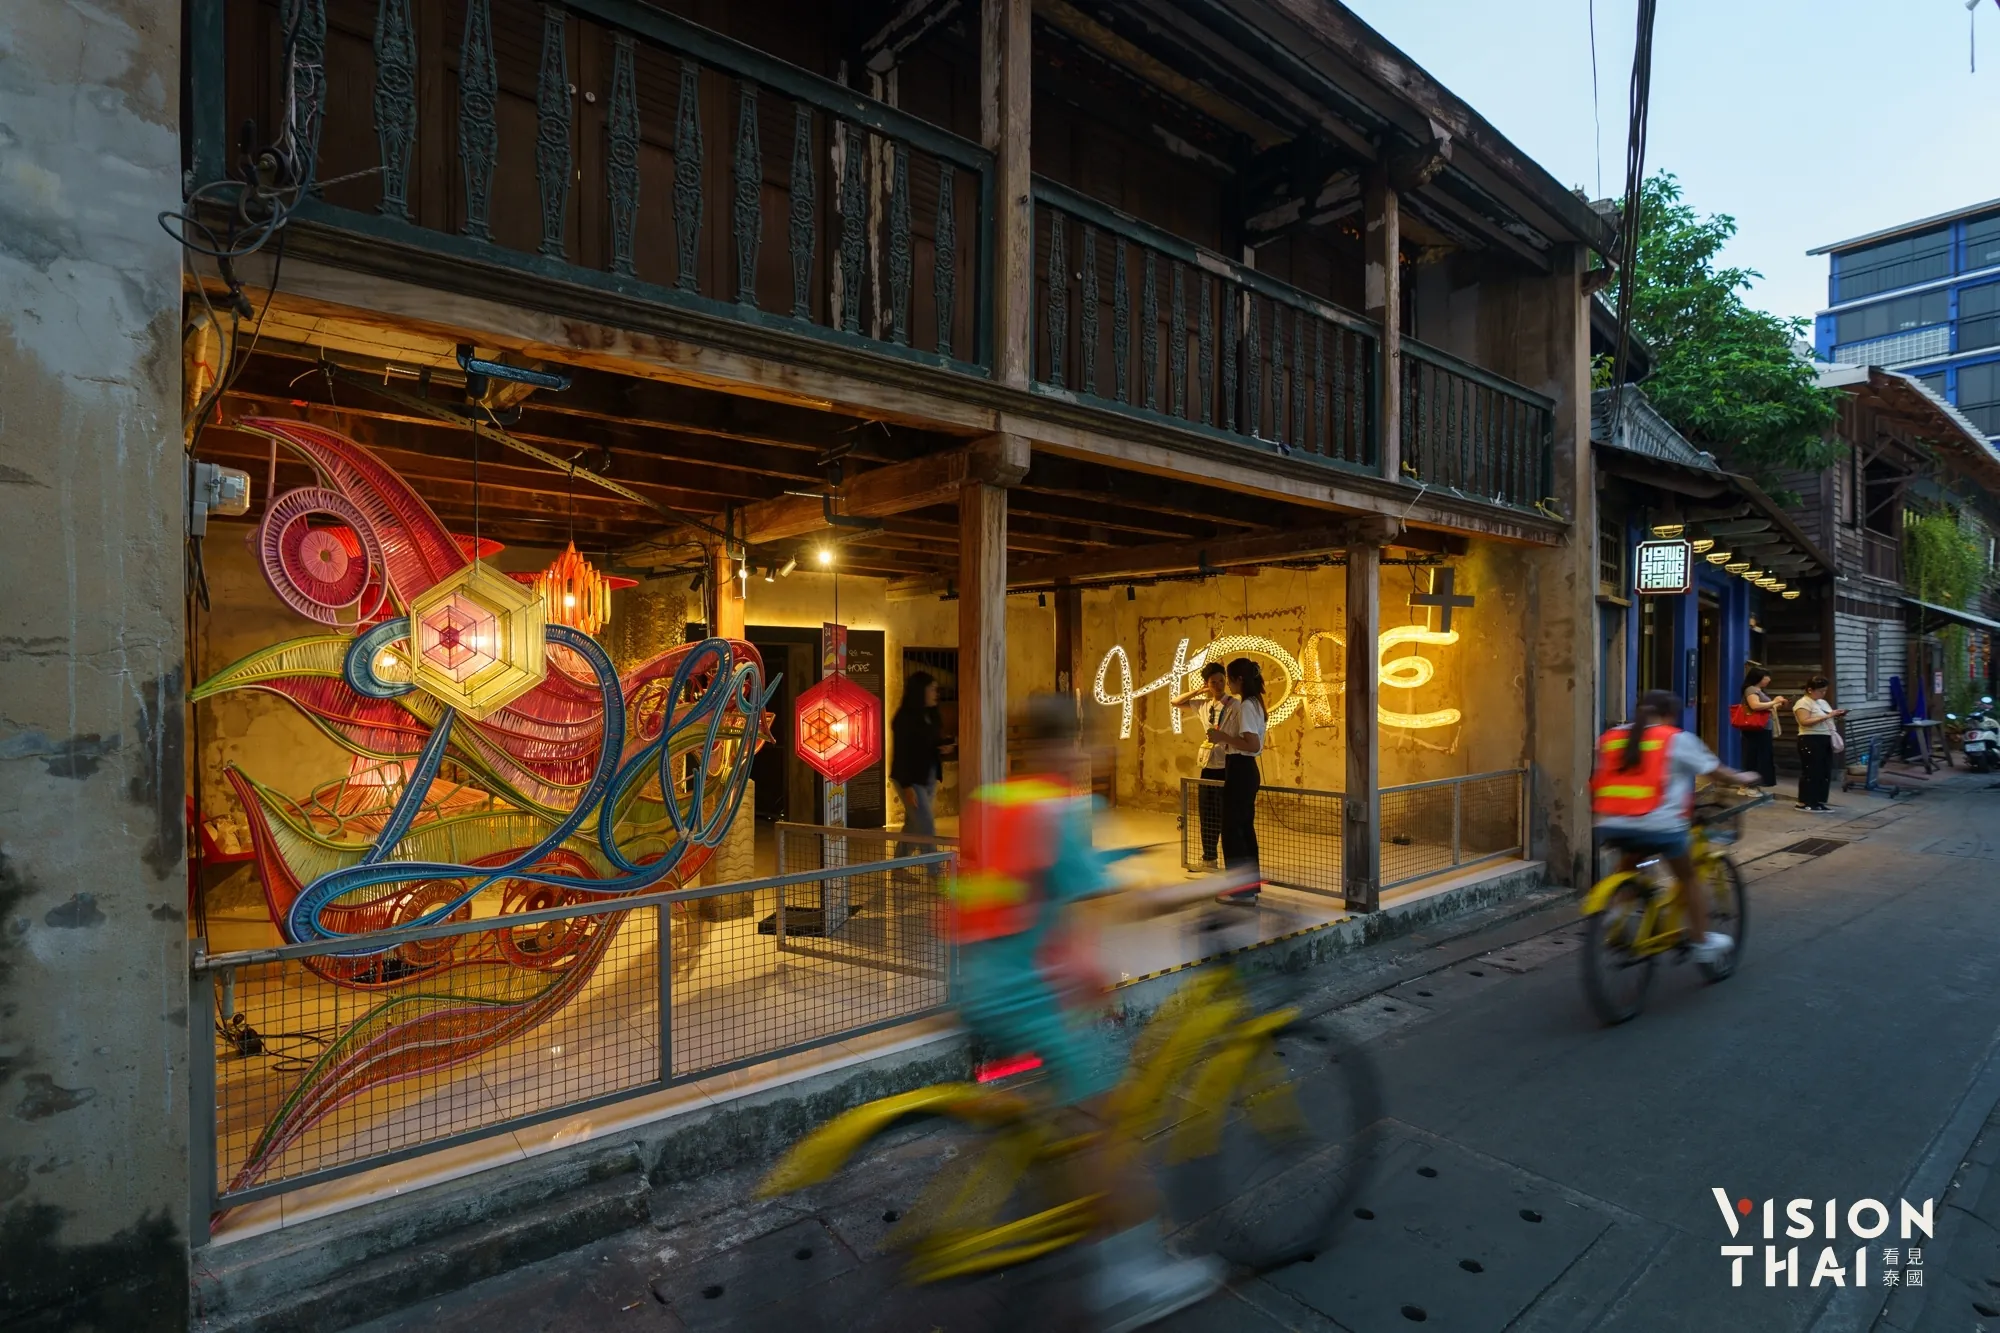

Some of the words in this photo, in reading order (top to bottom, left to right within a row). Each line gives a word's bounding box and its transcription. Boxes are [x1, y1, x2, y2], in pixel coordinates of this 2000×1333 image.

[1642, 545, 1685, 562] HONG
[1641, 560, 1685, 575] SIENG
[1640, 573, 1684, 589] KONG
